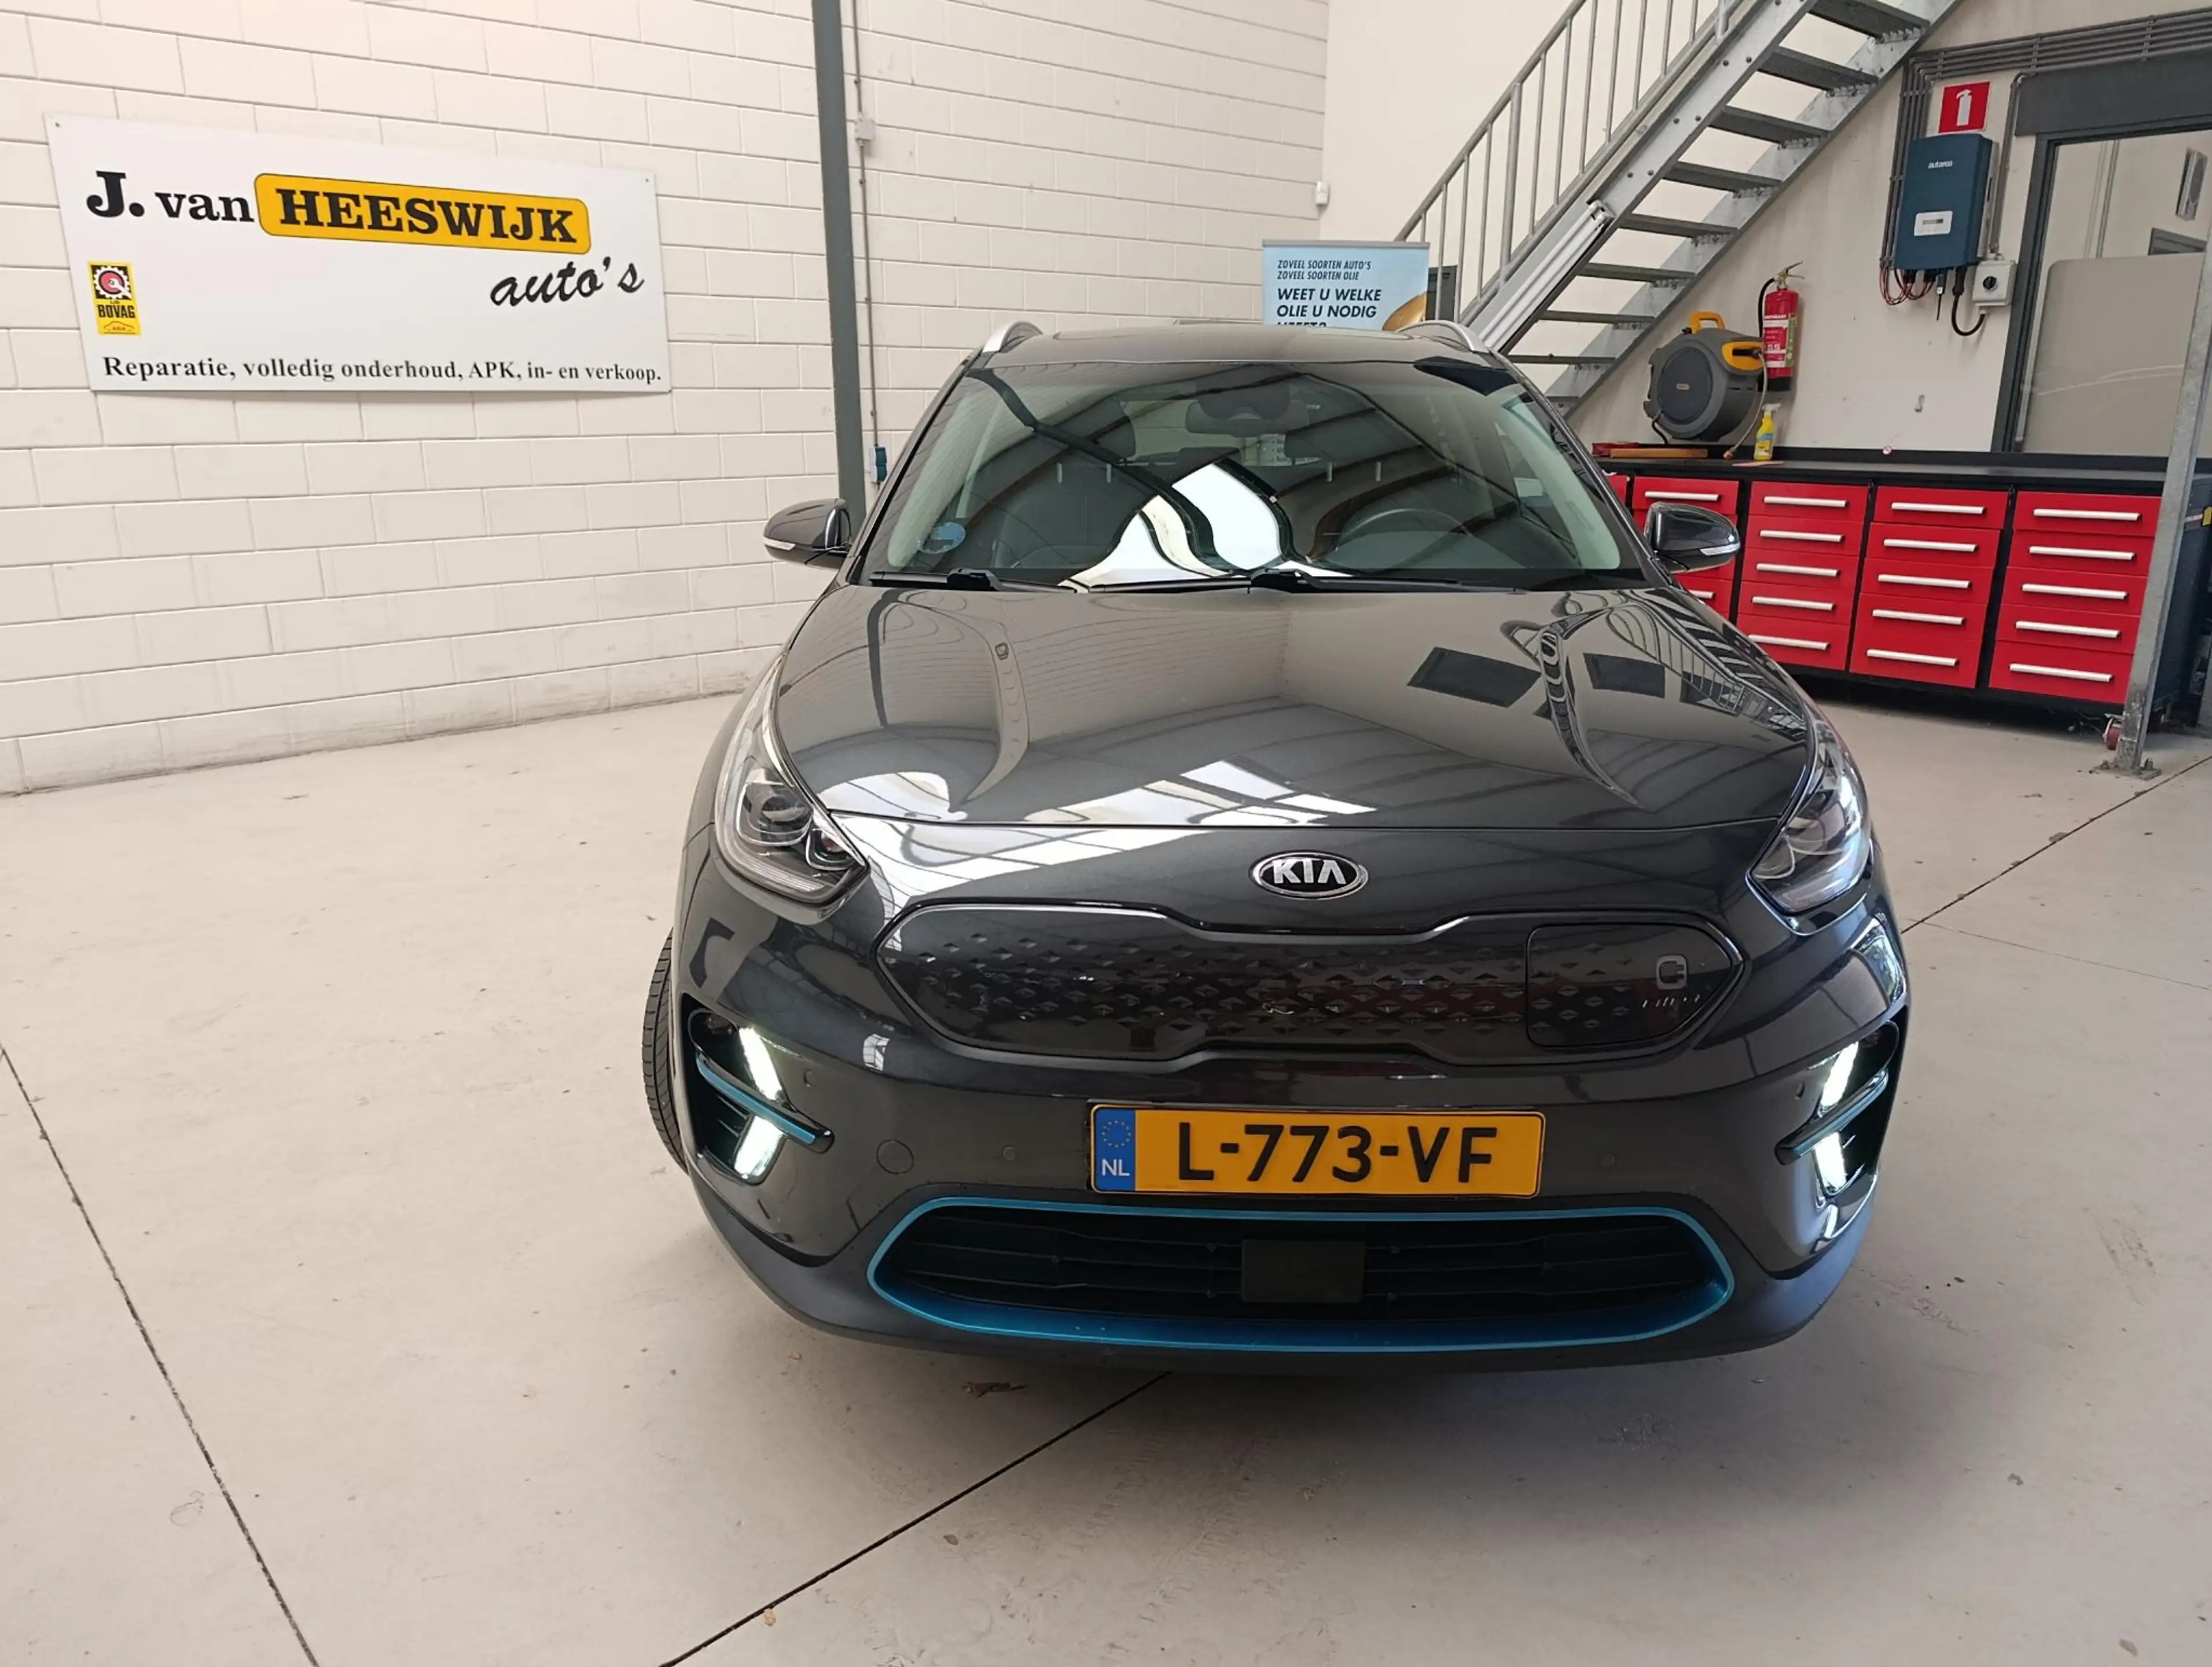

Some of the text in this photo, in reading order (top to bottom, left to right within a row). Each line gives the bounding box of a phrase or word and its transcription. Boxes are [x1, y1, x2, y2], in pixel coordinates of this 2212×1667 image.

[86, 170, 577, 243] J. van HEESWIJK
[1277, 260, 1372, 270] ZOVEEL SOORTEN AUTO'S
[490, 256, 645, 307] auto's
[1277, 271, 1359, 281] ZOVEEL SOORTEN OLIE
[1278, 288, 1381, 302] WEET U WELKE
[97, 304, 136, 318] BOVAG
[1277, 305, 1377, 318] OLIE U NODIG
[103, 357, 662, 385] Reparatie, volledig onderhoud, APK, in- en verkoop.
[1273, 859, 1347, 884] KIA
[1178, 1122, 1498, 1183] L-773-VF
[1101, 1158, 1130, 1176] NL
